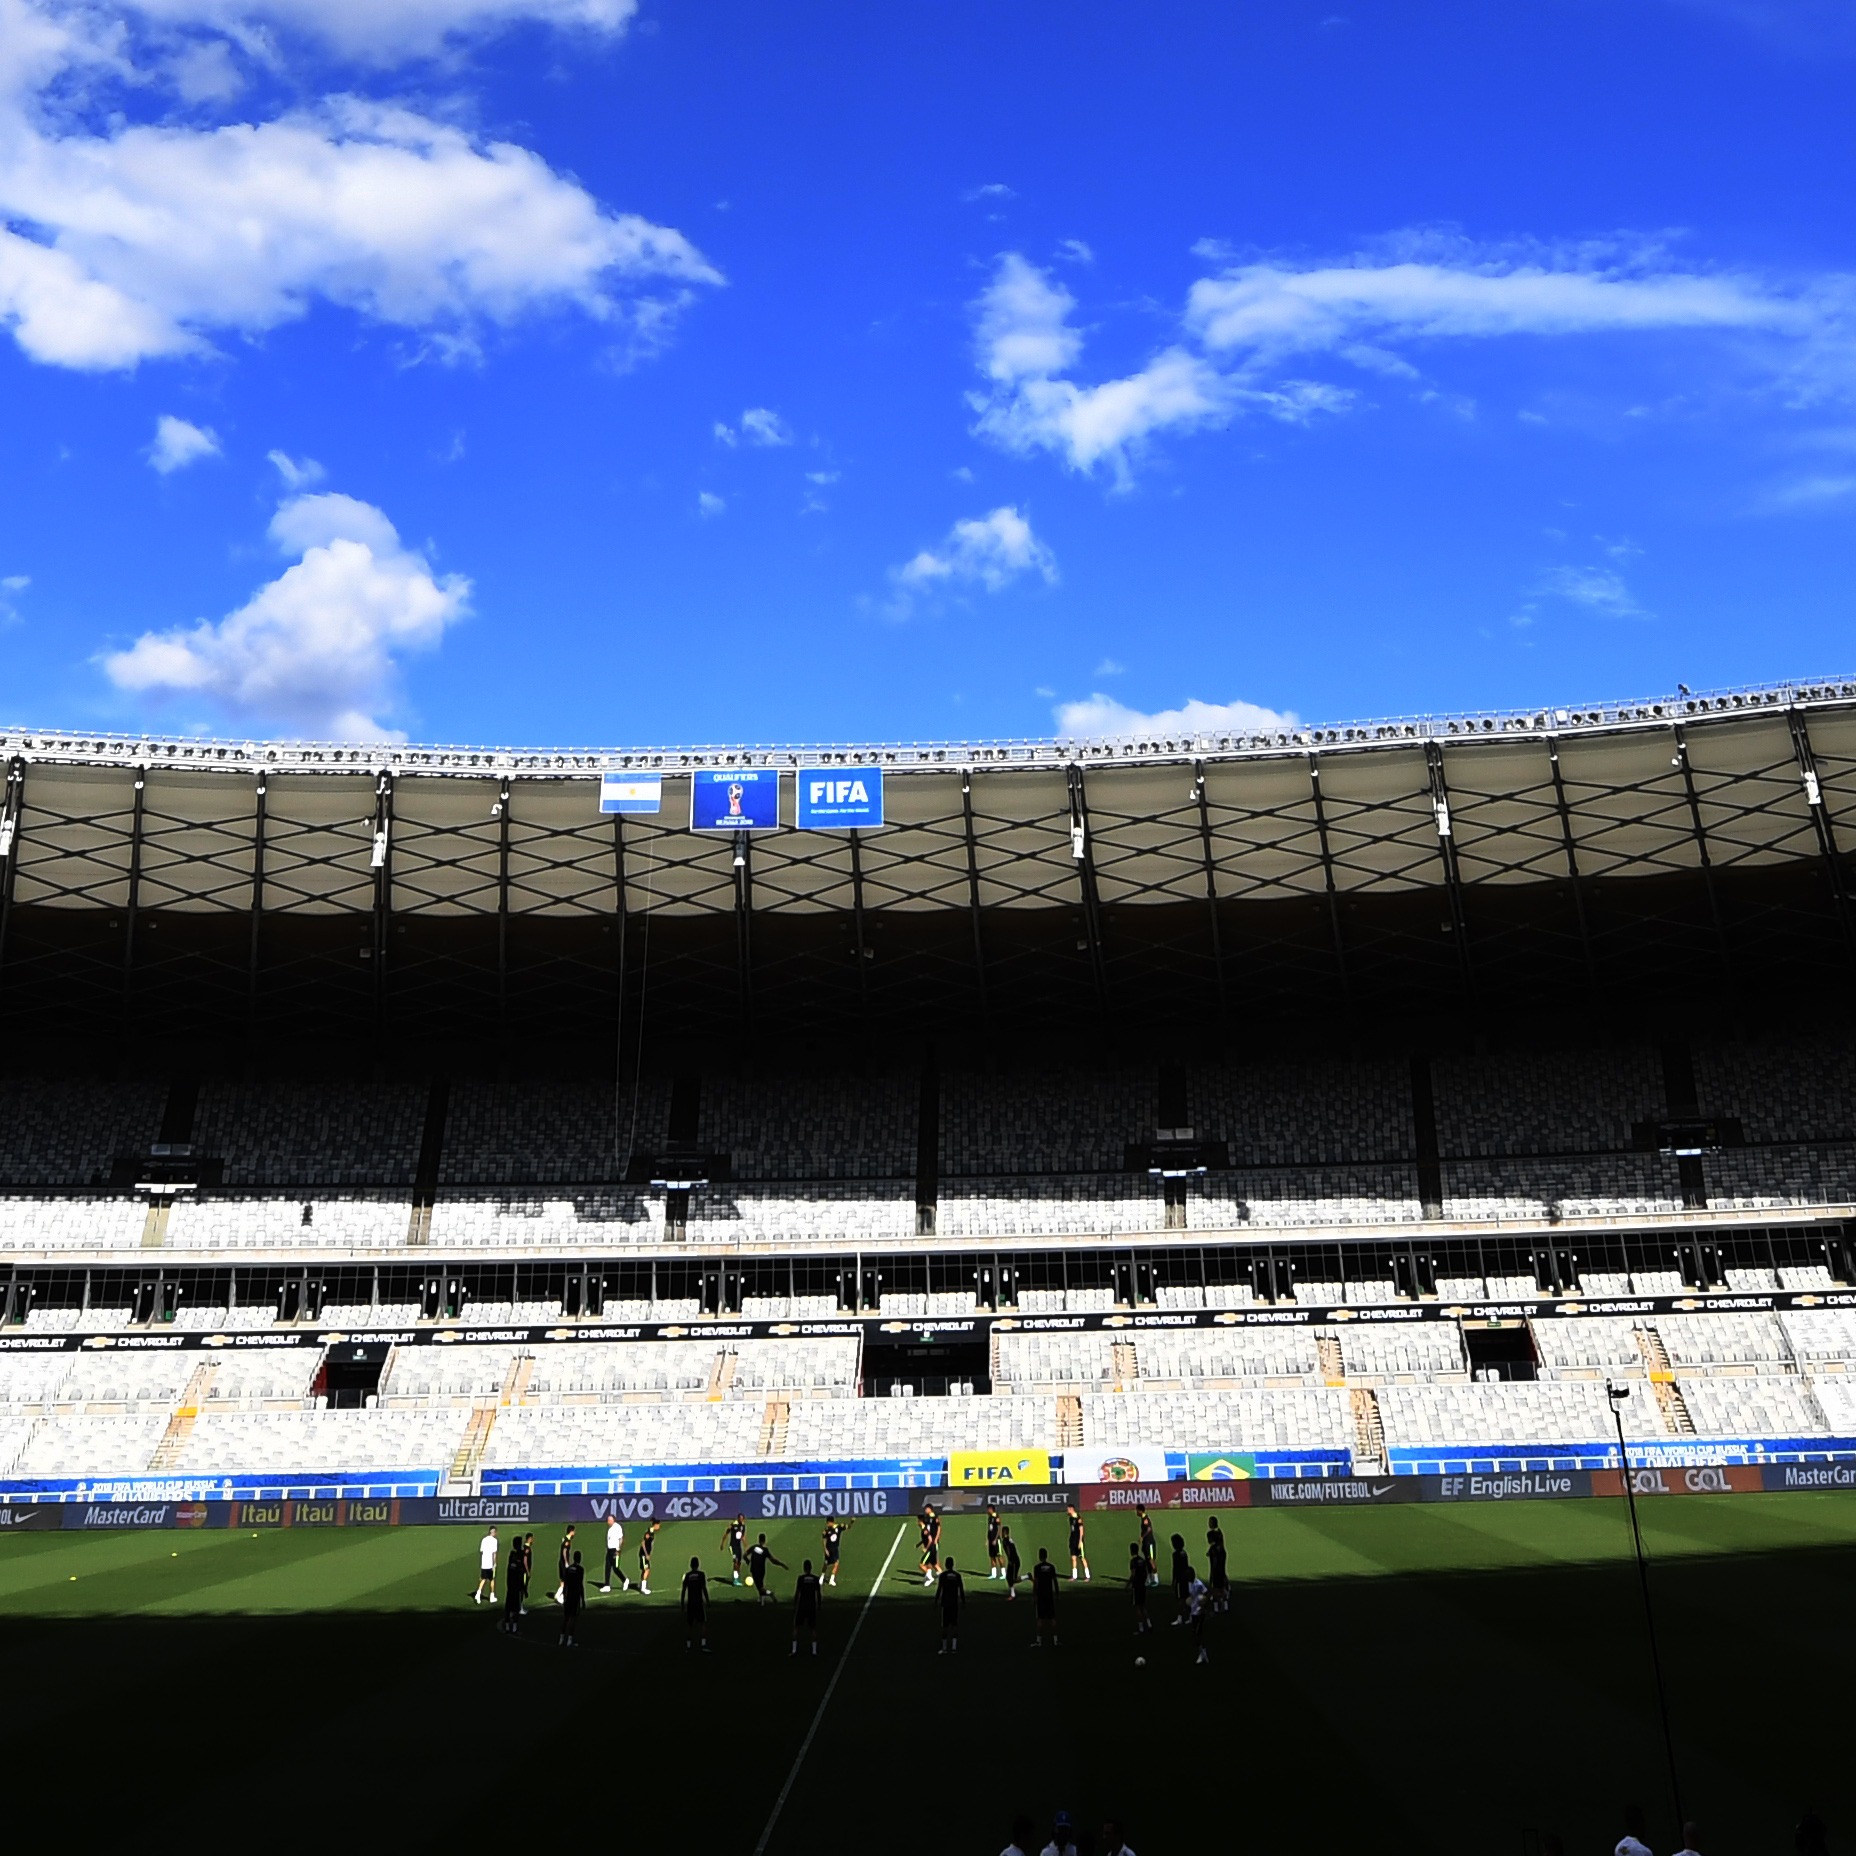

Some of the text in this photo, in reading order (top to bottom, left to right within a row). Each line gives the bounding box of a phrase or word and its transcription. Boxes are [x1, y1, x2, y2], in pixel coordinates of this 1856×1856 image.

[810, 781, 869, 804] FIFA
[1589, 1301, 1655, 1313] CHEVROLET
[1706, 1298, 1773, 1309] CHEVROLET
[1359, 1309, 1423, 1320] CHEVROLET
[1473, 1305, 1538, 1316] CHEVROLET
[1023, 1318, 1085, 1328] CHEVROLET
[1135, 1315, 1197, 1326] CHEVROLET
[1246, 1312, 1309, 1323] CHEVROLET
[690, 1326, 753, 1336] CHEVROLET
[801, 1323, 864, 1334] CHEVROLET
[912, 1321, 975, 1332] CHEVROLET
[351, 1333, 416, 1343] CHEVROLET
[465, 1331, 529, 1341] CHEVROLET
[577, 1328, 641, 1338] CHEVROLET
[0, 1338, 66, 1348] CHEVROLET
[117, 1337, 184, 1347] CHEVROLET
[235, 1335, 301, 1345] CHEVROLET
[1644, 1446, 1663, 1456] FIFA
[1664, 1446, 1696, 1456] WORLD
[1697, 1445, 1714, 1455] CUP
[964, 1466, 1013, 1481] FIFA
[1685, 1468, 1732, 1491] GOL
[1441, 1474, 1572, 1499] EF English Live
[1622, 1470, 1670, 1493] GOL
[1109, 1489, 1162, 1505] BRAHMA
[1182, 1487, 1236, 1503] BRAHMA
[1271, 1482, 1372, 1502] NIKE.COM/FUTEBOL
[762, 1491, 887, 1517] SAMSUNG
[987, 1493, 1070, 1505] CHEVROLET
[296, 1504, 334, 1522] Itaú
[349, 1502, 388, 1521] Itaú
[438, 1498, 530, 1517] ultrafarma
[590, 1497, 654, 1519] VIVO
[84, 1505, 165, 1525] MasterCard
[242, 1505, 280, 1523] Itaú
